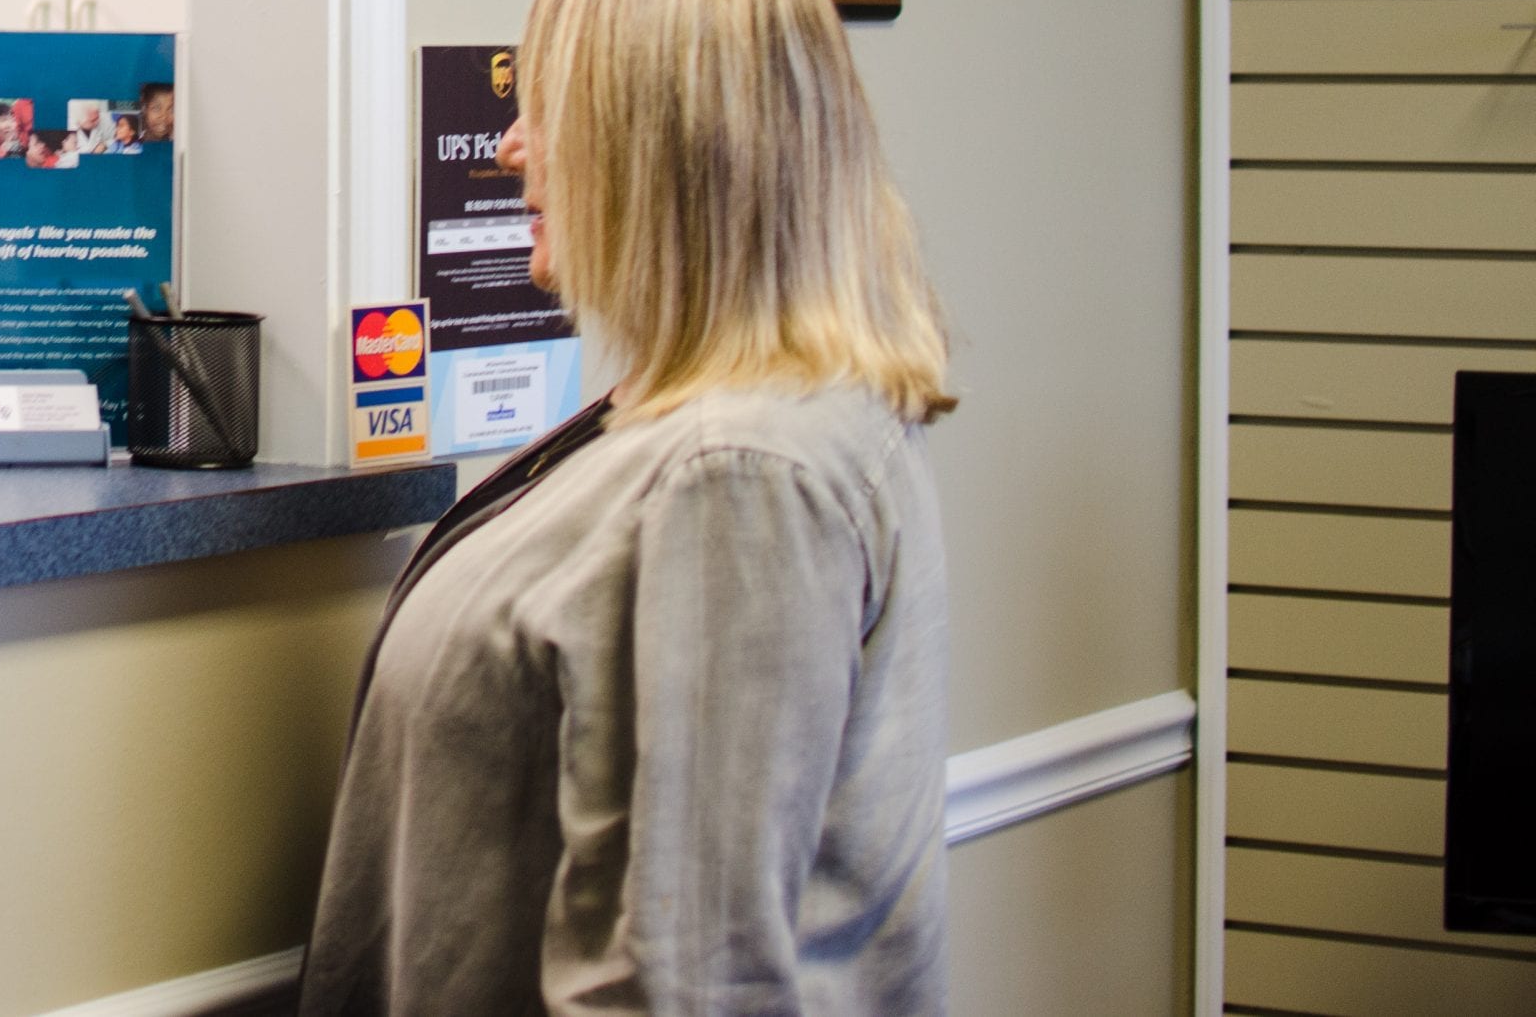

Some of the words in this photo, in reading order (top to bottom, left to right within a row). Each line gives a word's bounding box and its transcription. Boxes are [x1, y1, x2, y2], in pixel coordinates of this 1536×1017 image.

[437, 132, 471, 162] UPS
[39, 225, 65, 239] like
[66, 228, 93, 241] you
[93, 226, 133, 240] make
[134, 226, 157, 239] the
[17, 244, 33, 259] of
[33, 244, 89, 260] hearing
[89, 244, 148, 260] possible.
[355, 333, 421, 356] MasterCard
[368, 407, 414, 436] VISA
